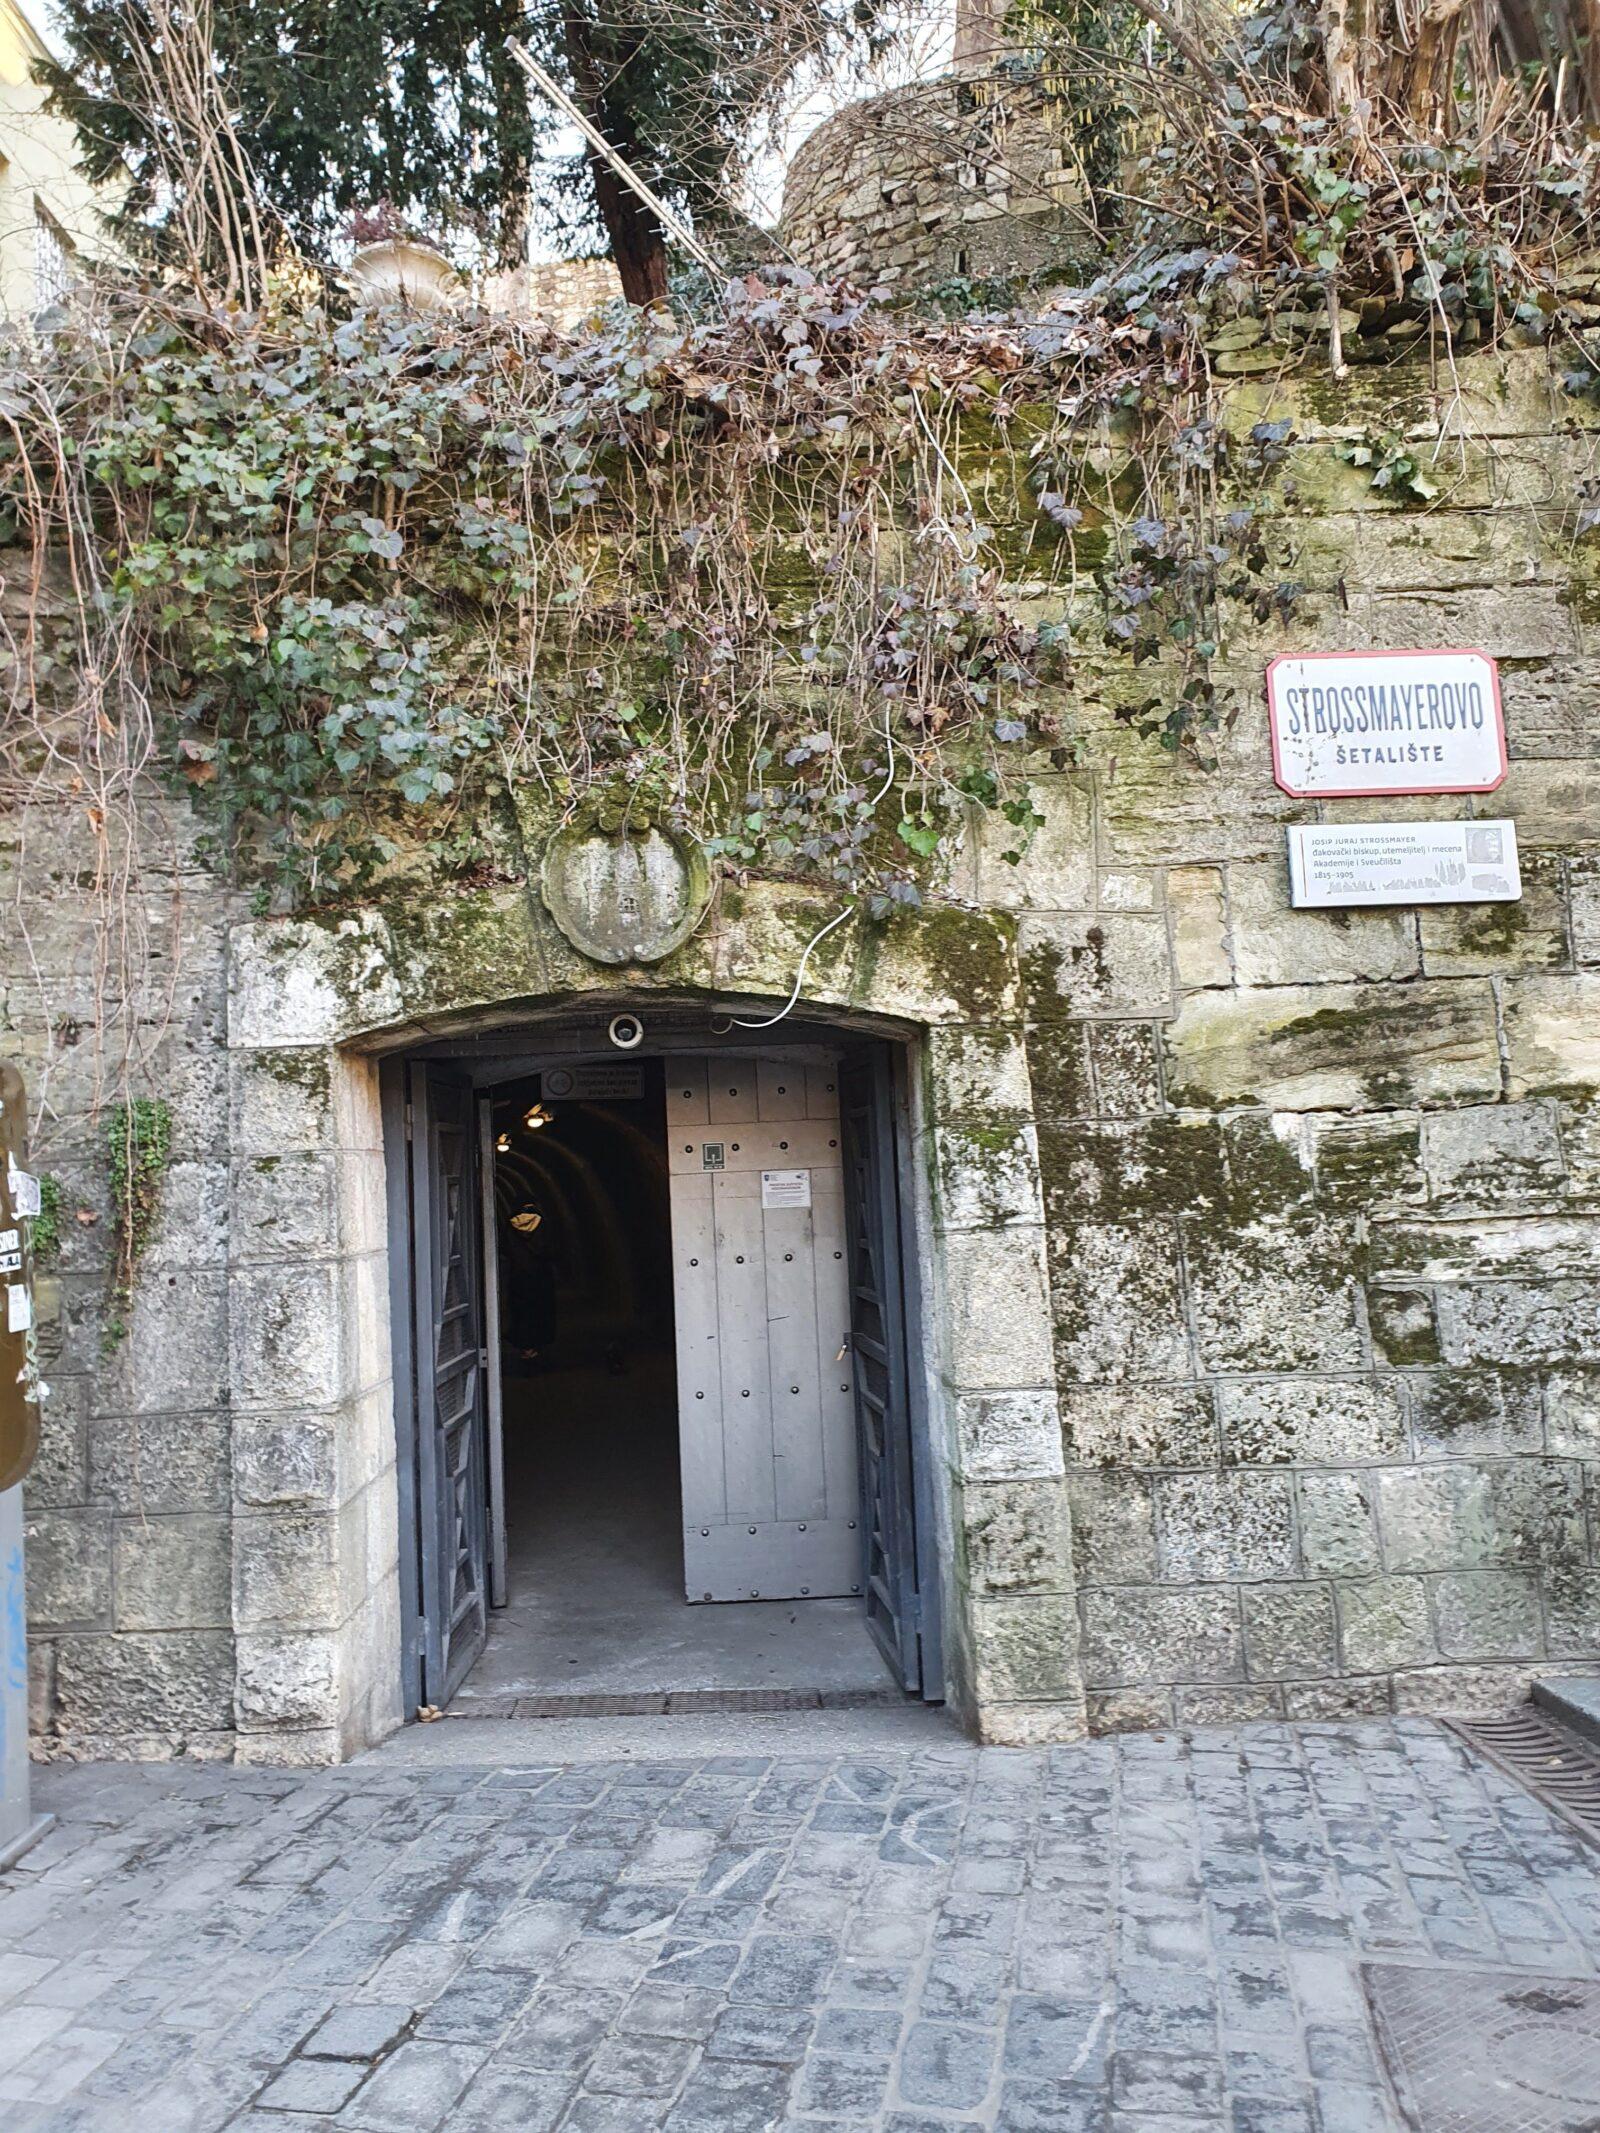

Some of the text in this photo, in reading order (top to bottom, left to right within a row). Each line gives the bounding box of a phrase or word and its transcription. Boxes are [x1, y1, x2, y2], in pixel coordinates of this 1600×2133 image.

[1287, 682, 1483, 734] STROSSMAYEROVO
[1336, 742, 1443, 765] ŠETALIŠTE
[1311, 836, 1416, 846] JOSIP JURAJ STROSSMAYER
[1312, 847, 1351, 857] đakovački
[1353, 847, 1381, 856] biskup,
[1382, 845, 1425, 856] utemeljitelj
[1432, 845, 1462, 853] mecena
[1313, 859, 1354, 868] Akademije
[1361, 857, 1402, 866] Sveučilišta
